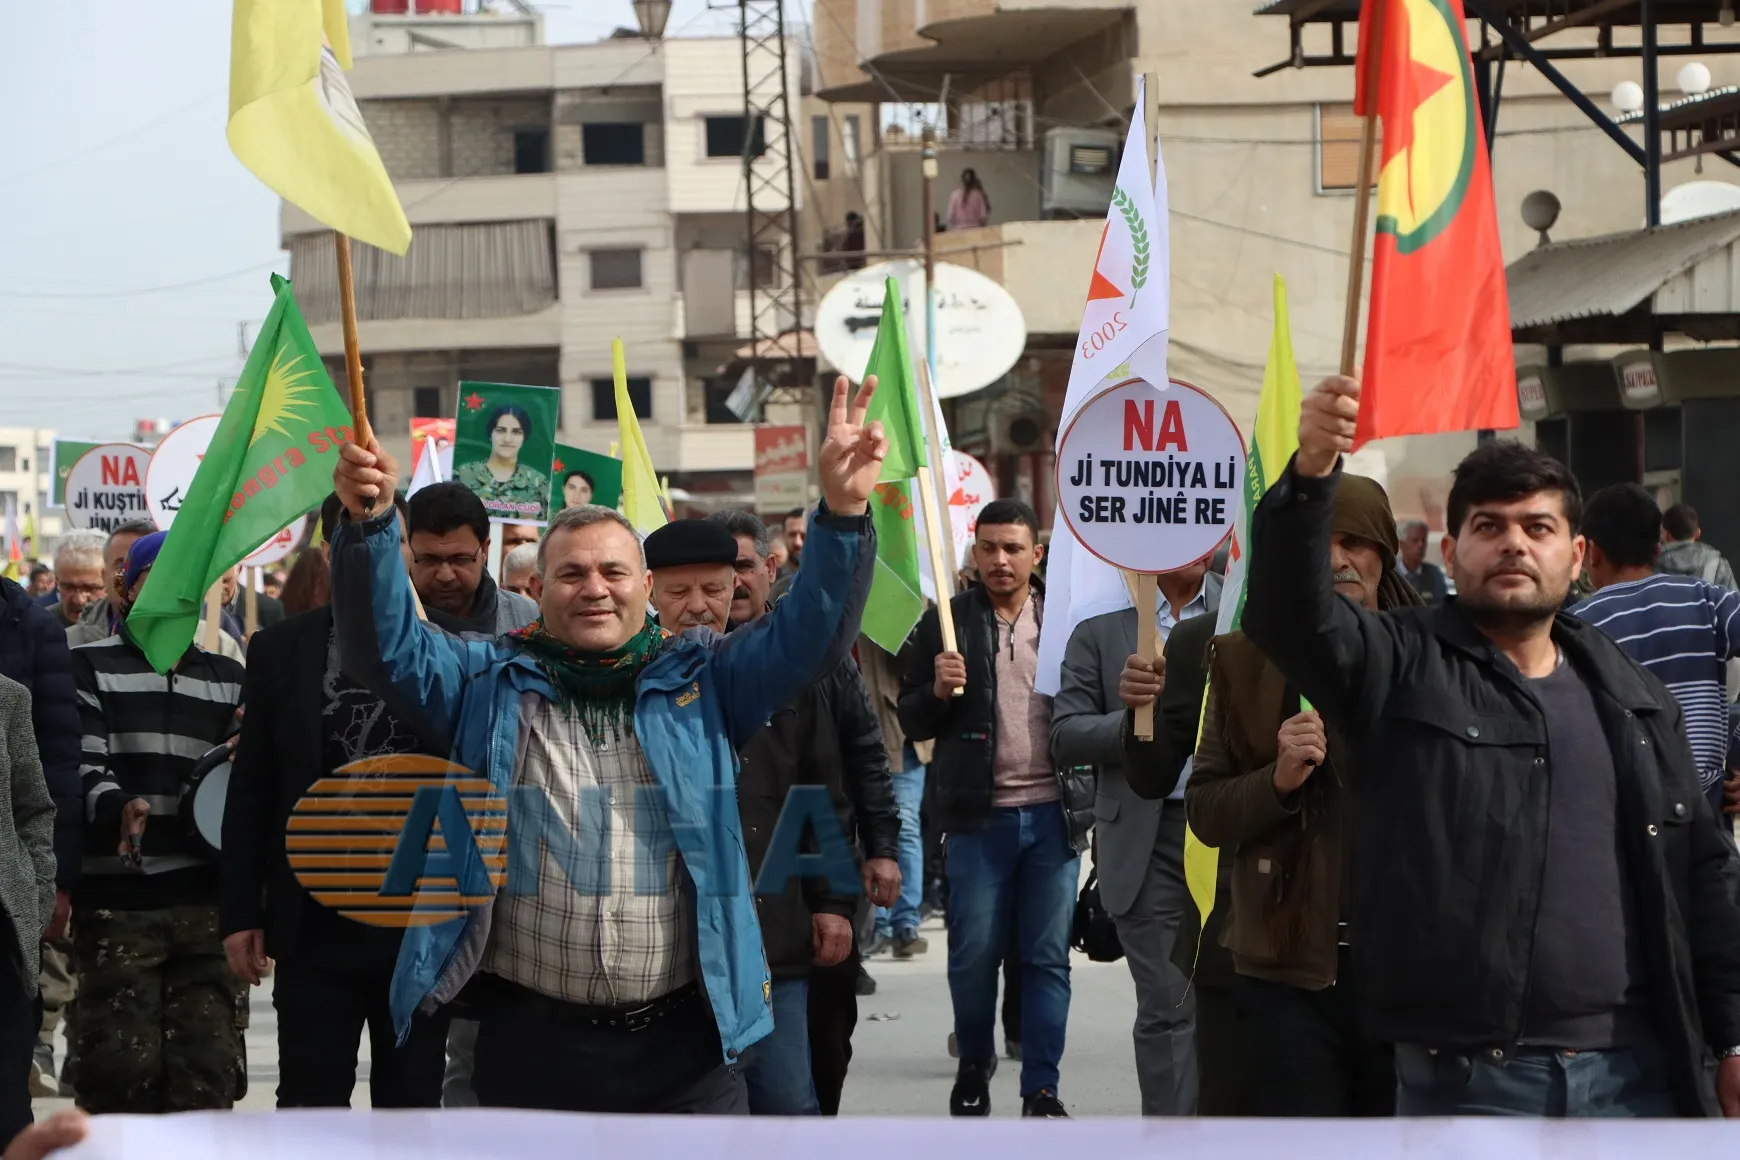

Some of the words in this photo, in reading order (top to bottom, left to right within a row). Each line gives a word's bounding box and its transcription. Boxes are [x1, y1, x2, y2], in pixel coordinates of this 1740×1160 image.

[308, 425, 355, 454] Sta
[1123, 399, 1188, 452] NA
[101, 455, 141, 486] NA
[1079, 495, 1126, 523] SER
[1195, 498, 1225, 525] RE
